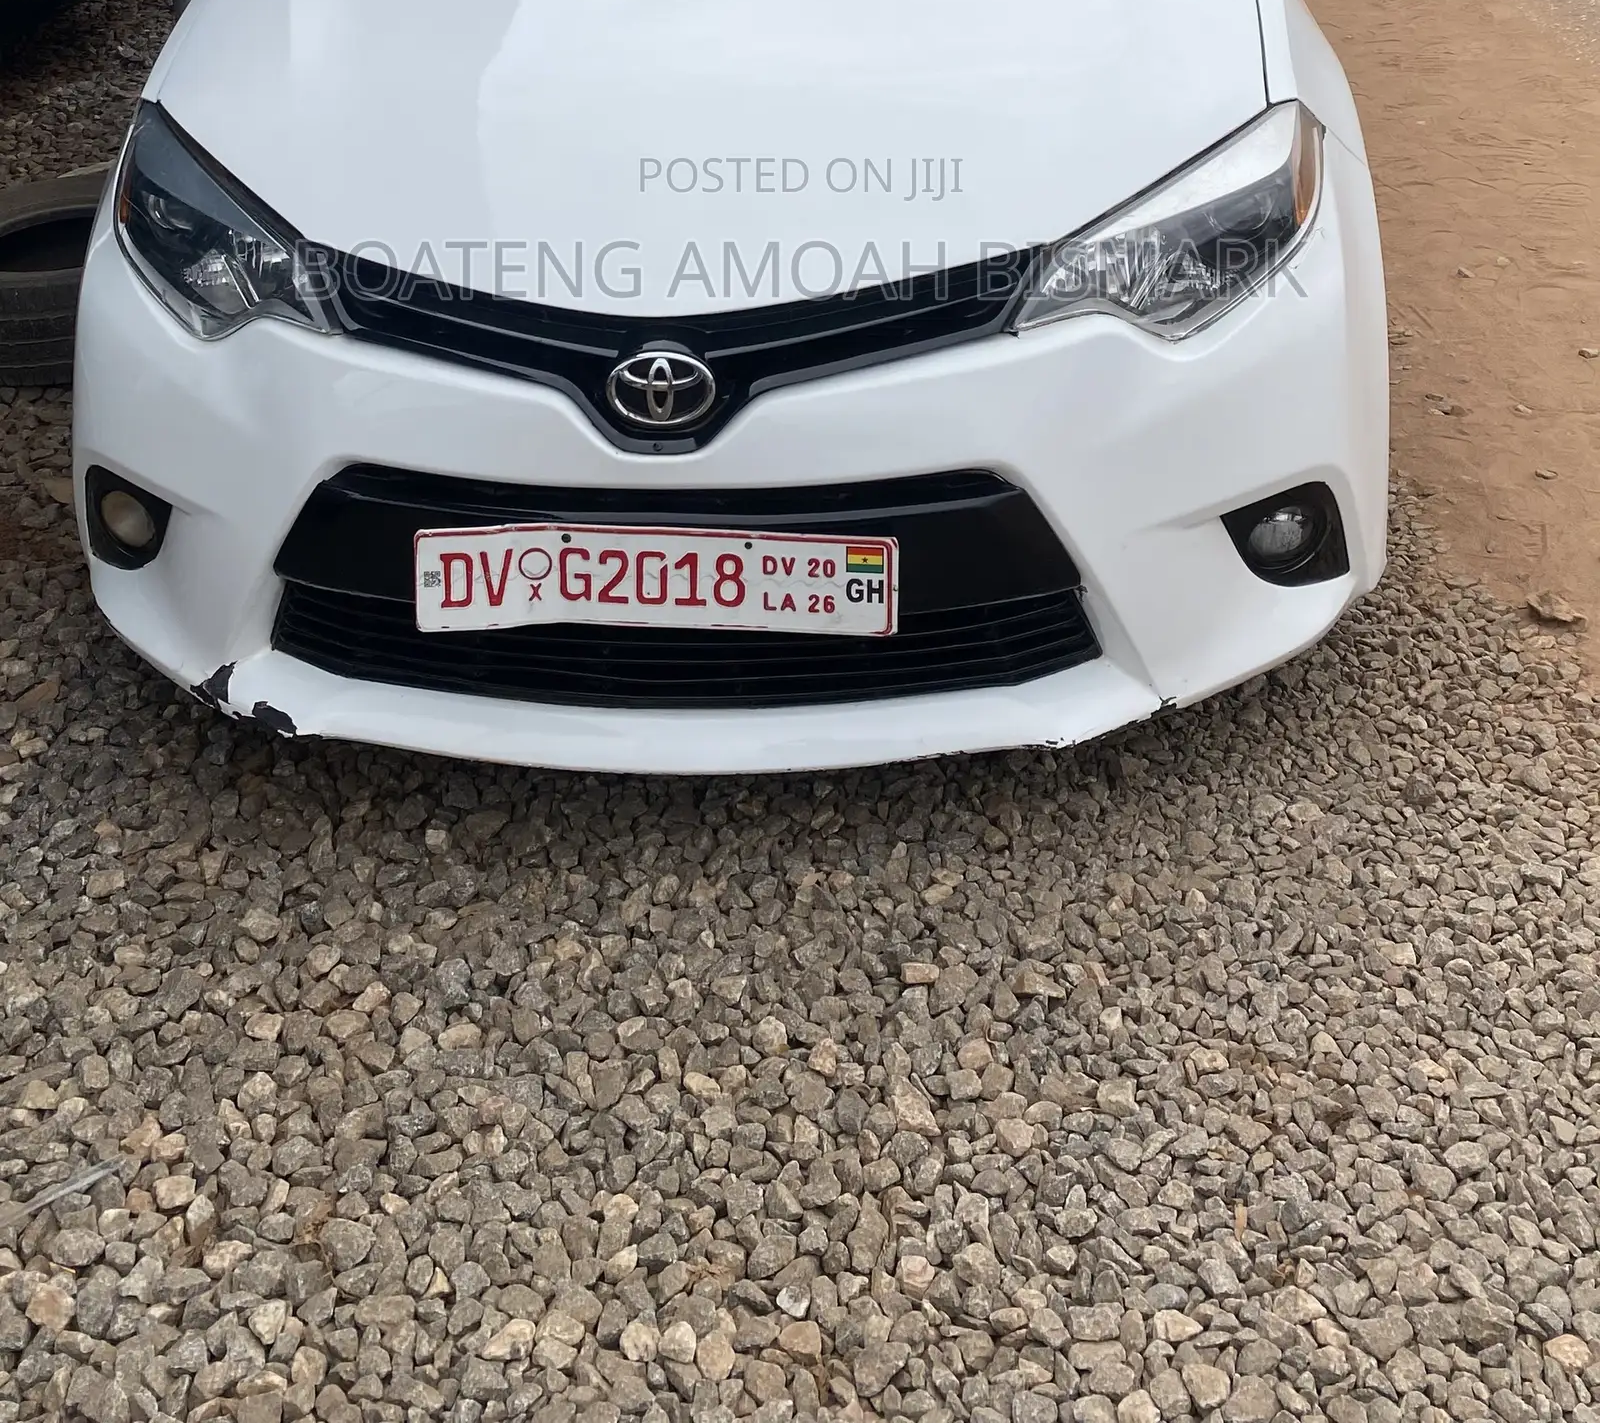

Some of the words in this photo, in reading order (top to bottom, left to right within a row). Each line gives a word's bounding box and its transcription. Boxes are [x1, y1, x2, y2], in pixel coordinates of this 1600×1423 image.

[440, 548, 513, 608] DV
[558, 547, 746, 608] G2018
[762, 555, 796, 576] DV
[807, 558, 836, 578] 20
[763, 591, 796, 612] LA
[807, 594, 836, 613] 26
[845, 578, 884, 604] GH
